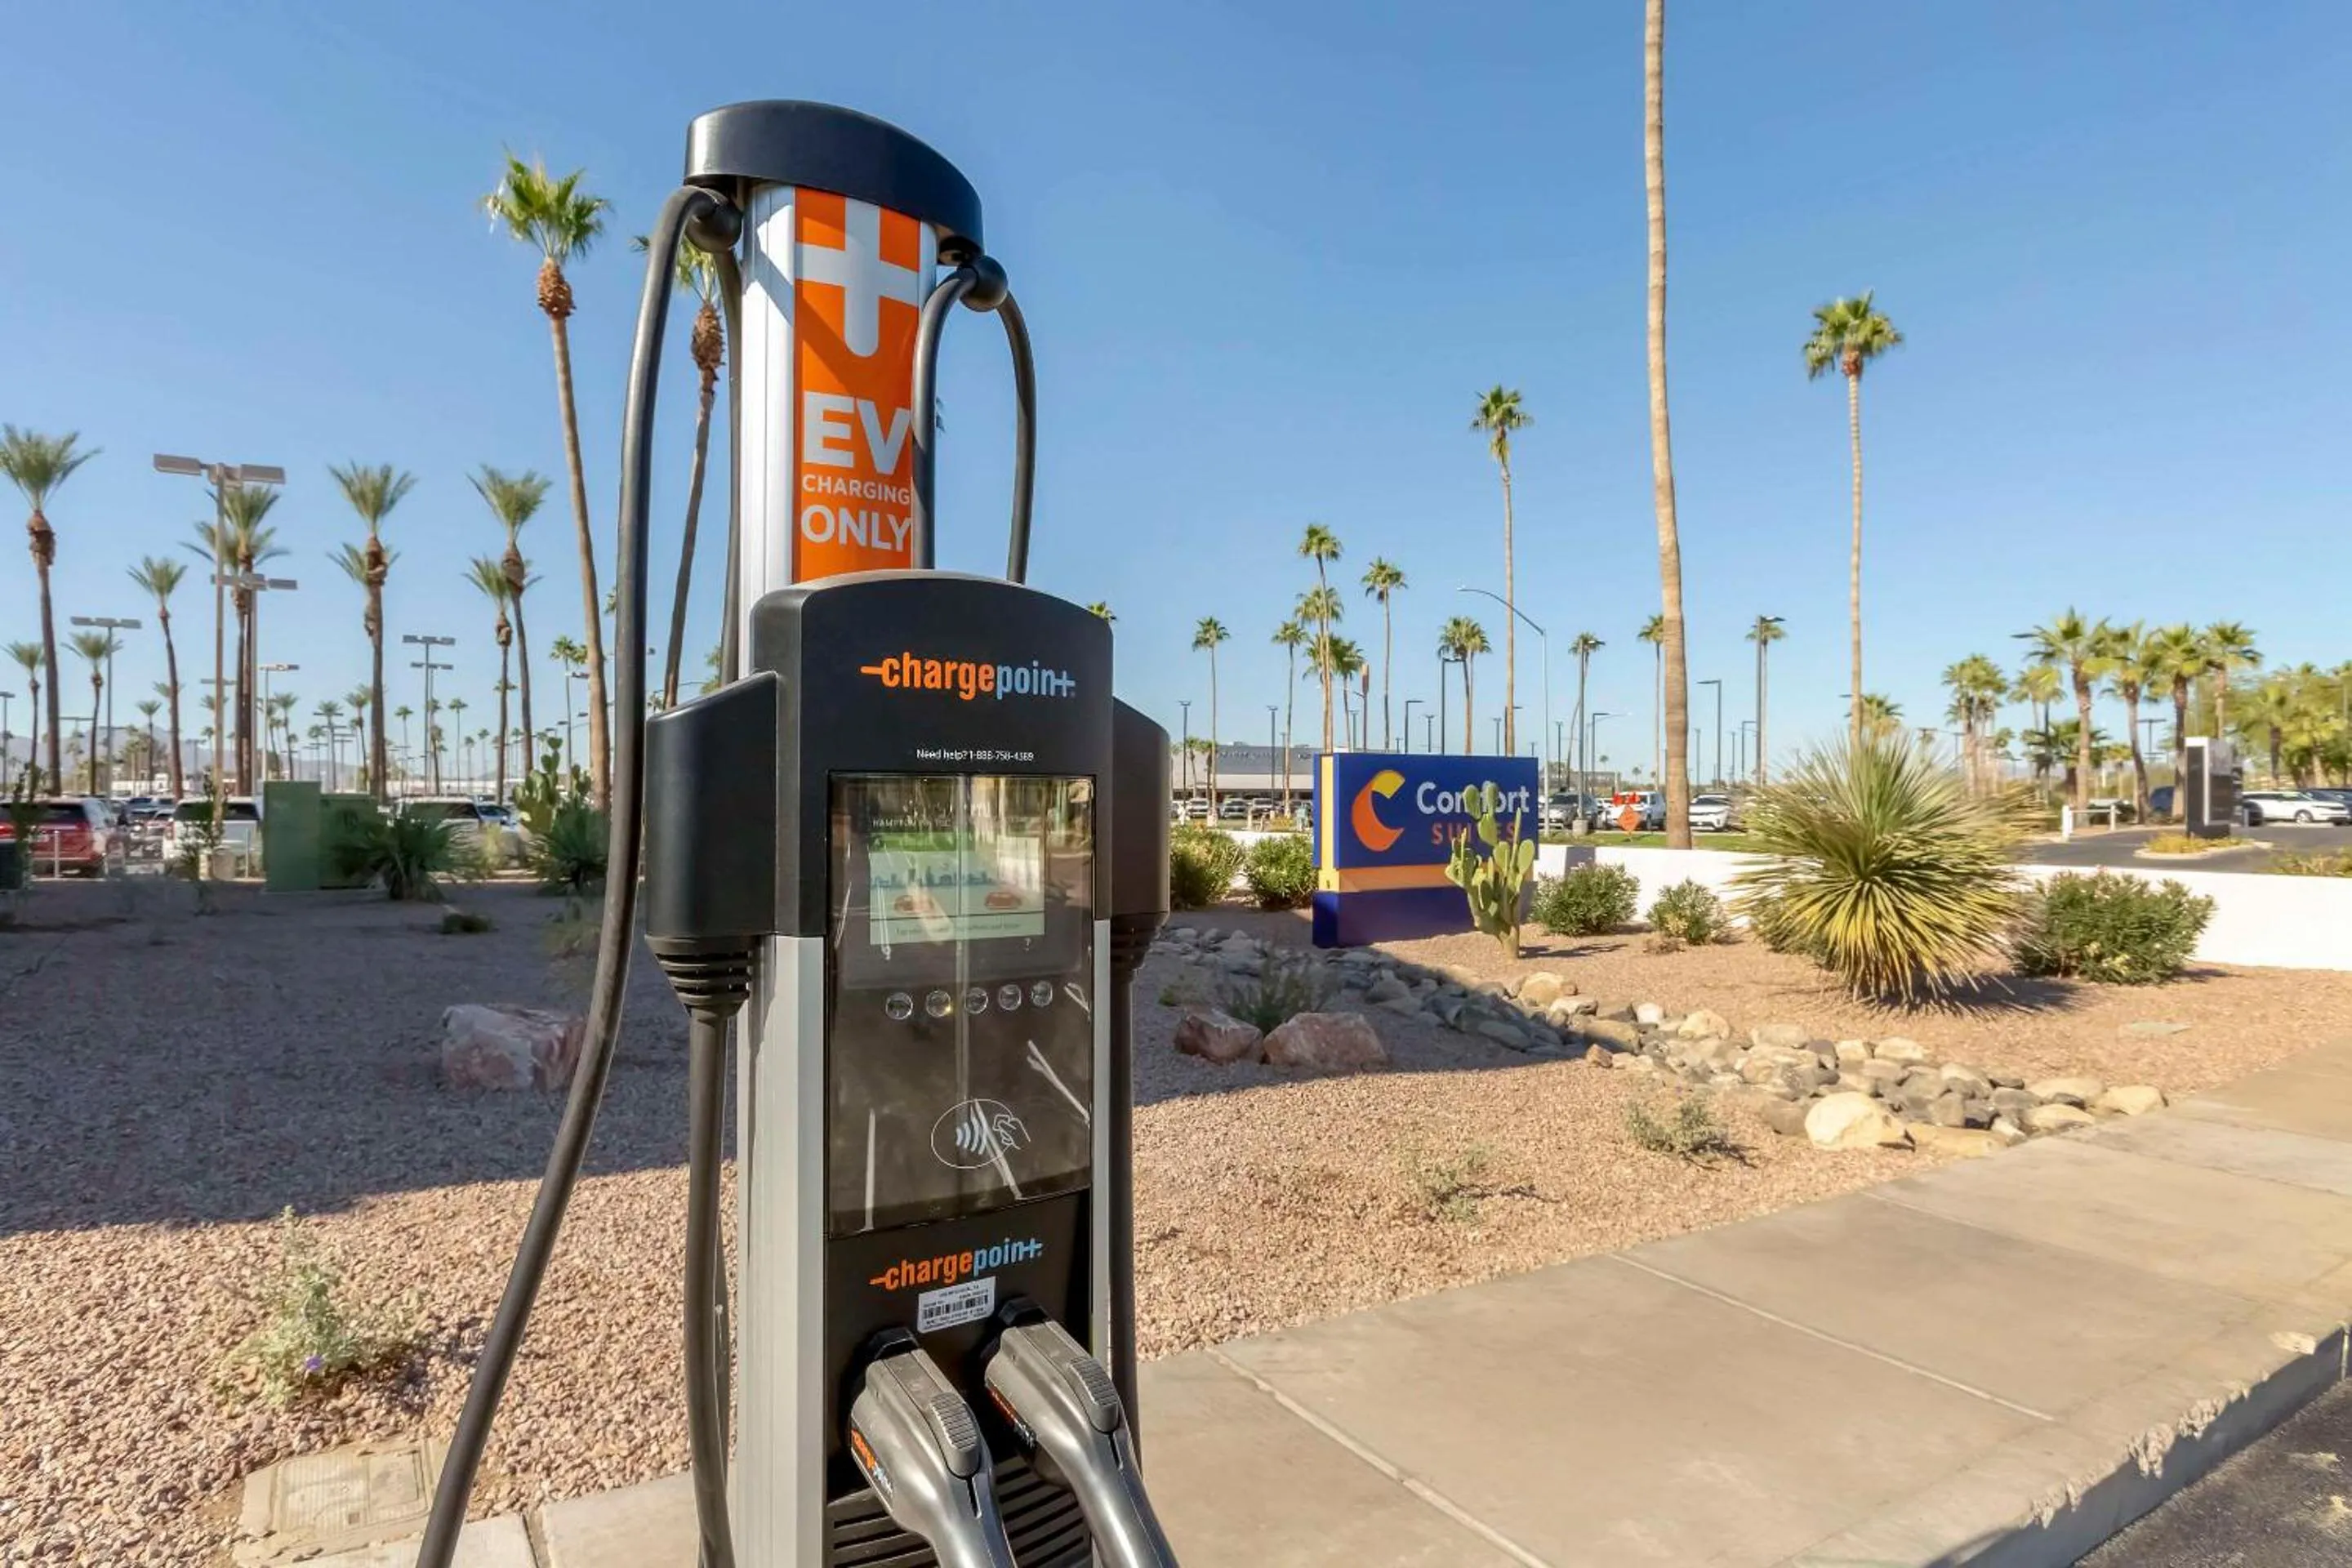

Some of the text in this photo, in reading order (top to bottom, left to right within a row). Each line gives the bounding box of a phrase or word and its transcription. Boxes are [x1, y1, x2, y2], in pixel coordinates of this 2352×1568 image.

[804, 390, 912, 474] EV
[801, 474, 911, 504] CHARGING
[801, 504, 912, 553] ONLY
[916, 748, 942, 760] Need
[943, 748, 969, 761] help?
